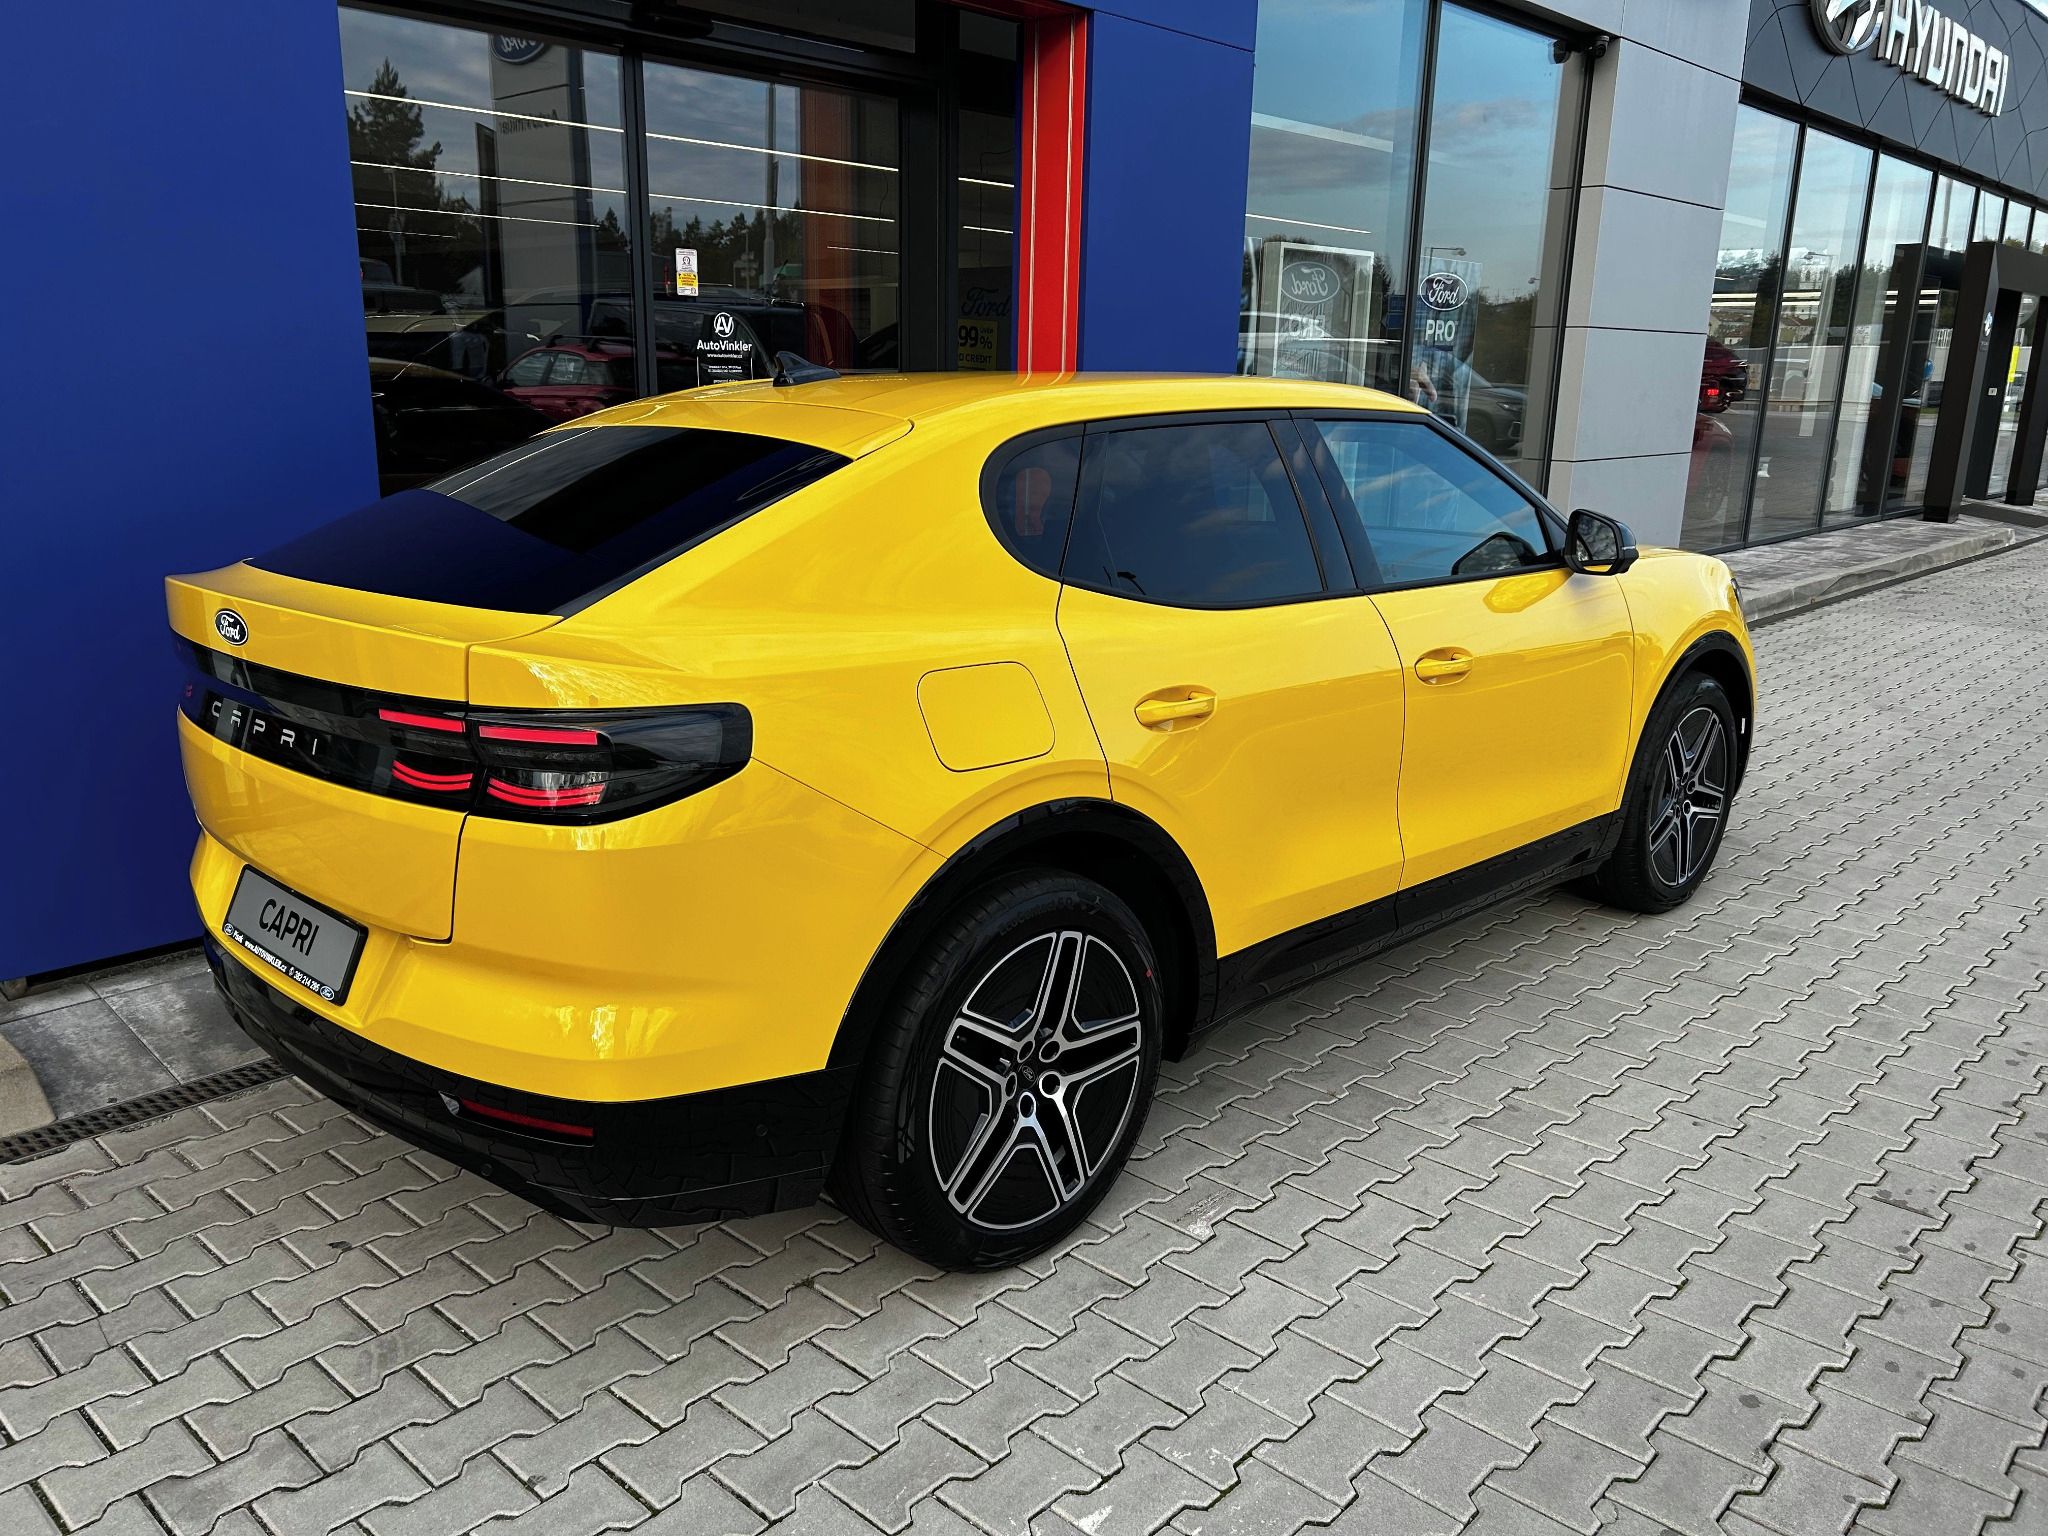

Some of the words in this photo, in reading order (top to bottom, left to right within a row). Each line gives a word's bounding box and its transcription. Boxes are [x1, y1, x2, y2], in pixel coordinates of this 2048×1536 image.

[1877, 0, 2009, 117] HYUNDAI
[1428, 276, 1460, 304] Ford
[1425, 319, 1456, 341] PRO
[697, 339, 753, 352] AutoVinkler
[965, 353, 993, 365] CREDIT
[219, 614, 241, 641] Ford
[211, 701, 318, 756] CAPRI
[258, 898, 320, 957] CAPRI
